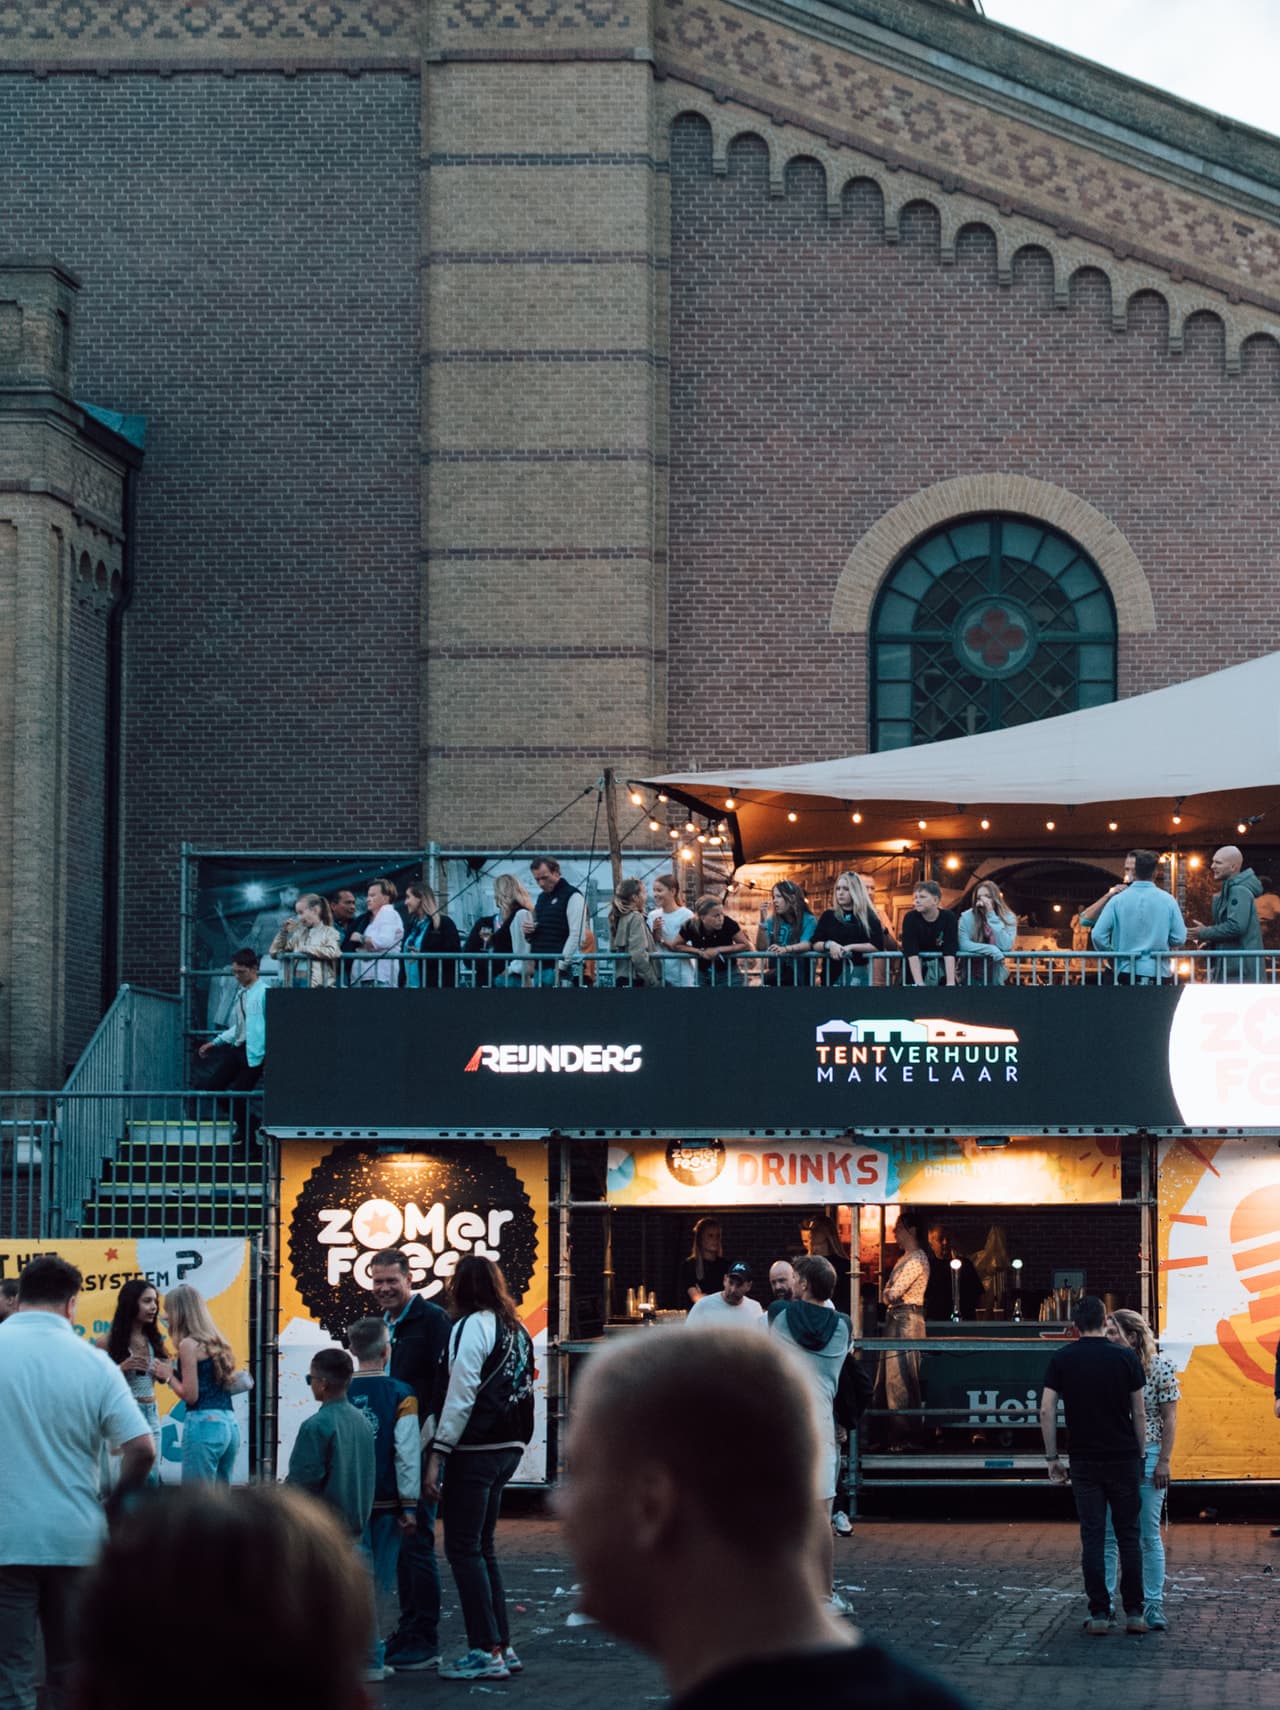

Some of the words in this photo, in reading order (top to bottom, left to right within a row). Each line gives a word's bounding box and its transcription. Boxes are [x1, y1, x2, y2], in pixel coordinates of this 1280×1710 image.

[816, 1046, 1019, 1064] TENTVERHUUR
[816, 1066, 1019, 1083] MAKELAAR
[736, 1151, 879, 1186] DRINKS
